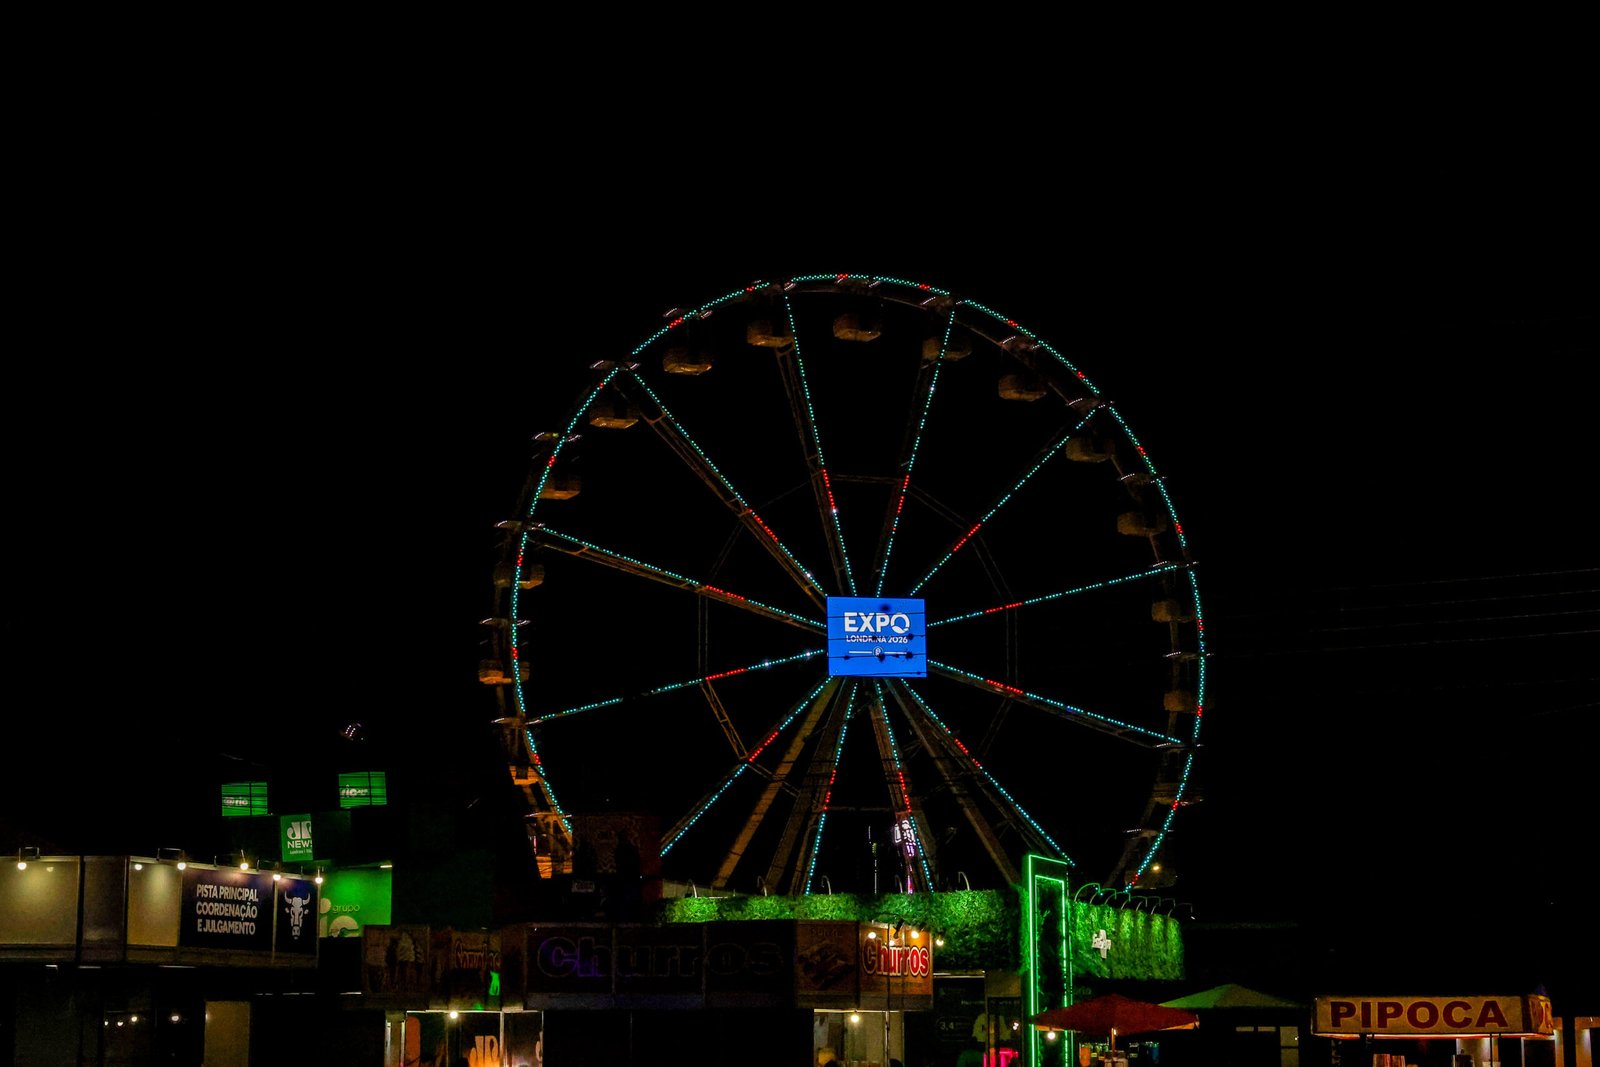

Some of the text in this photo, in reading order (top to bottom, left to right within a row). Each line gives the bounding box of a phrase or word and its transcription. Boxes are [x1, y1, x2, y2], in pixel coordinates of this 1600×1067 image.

[844, 612, 910, 634] EXPO
[888, 636, 908, 644] 2026
[196, 884, 259, 902] PISTA PRINCIPAL
[196, 901, 258, 920] COORDENAÇÃO
[332, 904, 361, 914] grupo
[197, 919, 256, 935] E JULGAMENTO
[537, 936, 785, 978] Churros
[862, 937, 929, 978] Churros
[1330, 1000, 1508, 1029] PIPOCA
